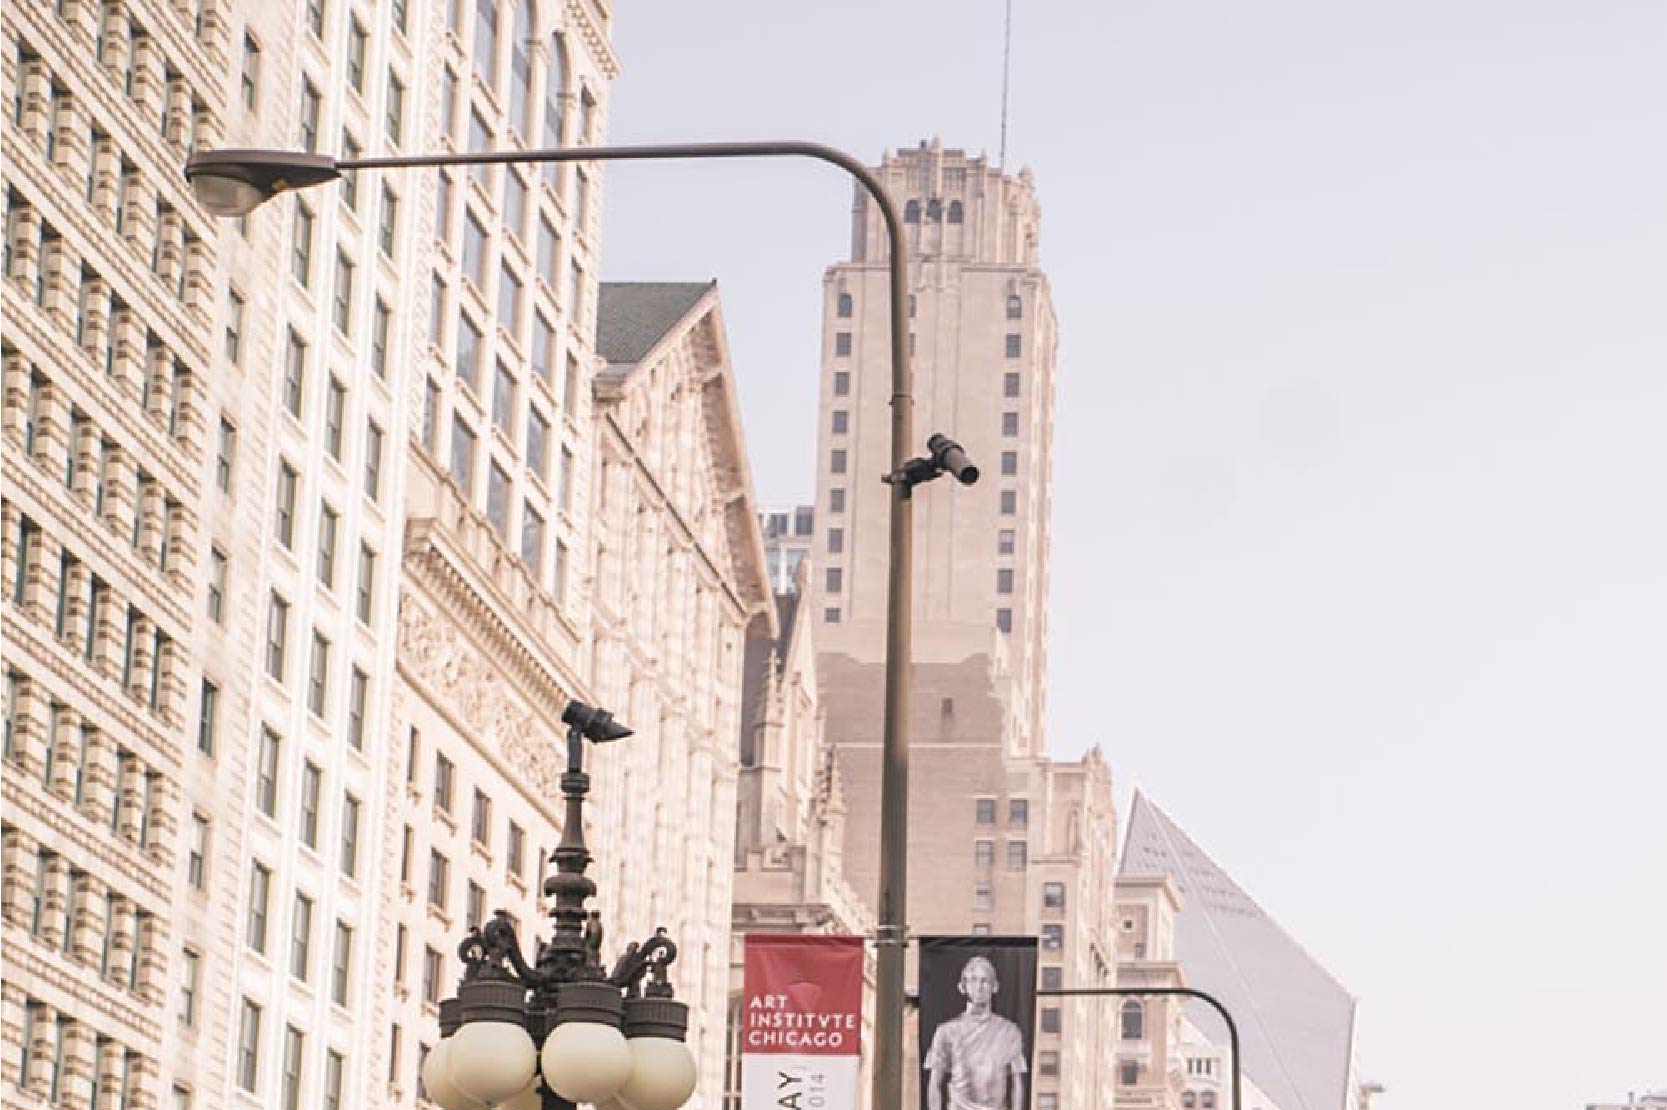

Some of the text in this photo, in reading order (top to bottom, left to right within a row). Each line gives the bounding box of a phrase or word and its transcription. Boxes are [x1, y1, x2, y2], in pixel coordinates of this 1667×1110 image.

[750, 994, 787, 1009] ART
[750, 1012, 855, 1029] INSTITVTE
[748, 1030, 842, 1047] CHICAGO
